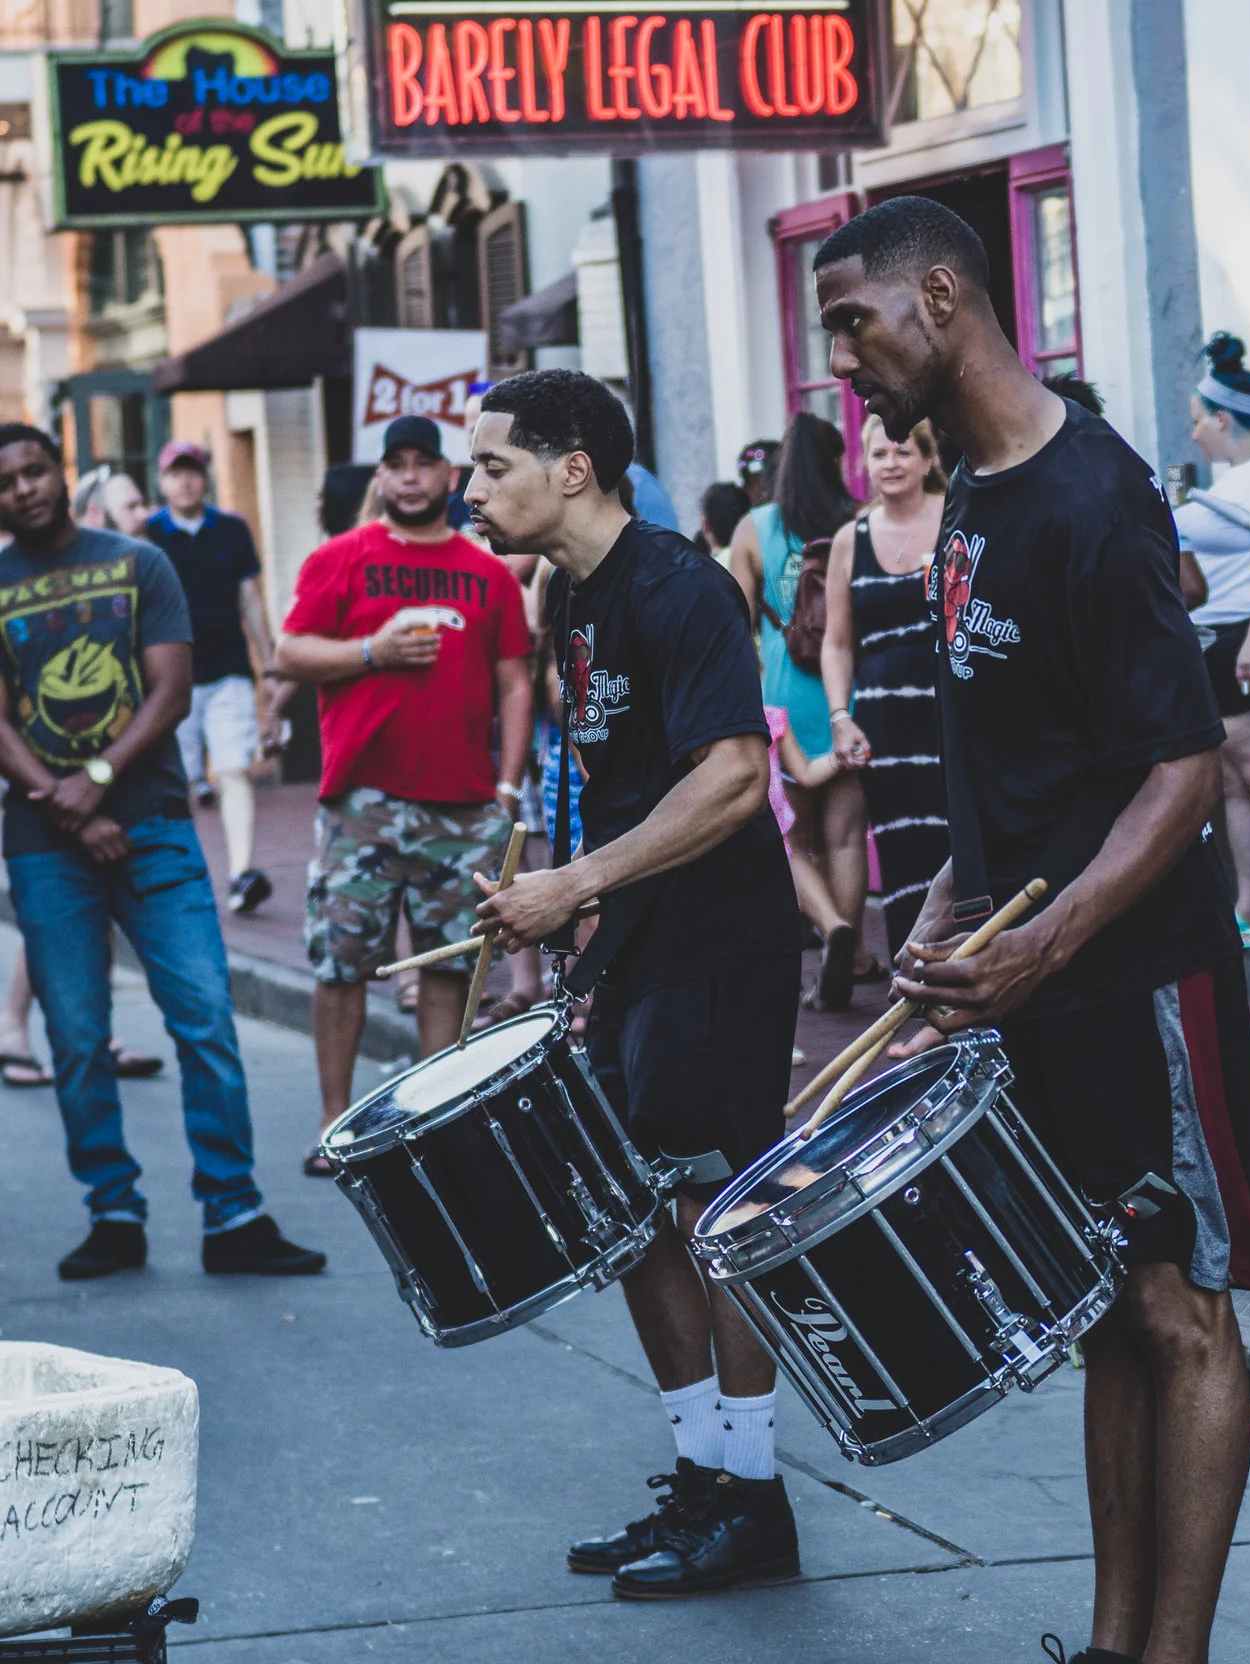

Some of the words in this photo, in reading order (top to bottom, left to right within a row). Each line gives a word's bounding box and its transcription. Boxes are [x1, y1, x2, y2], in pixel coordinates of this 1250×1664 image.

[86, 69, 169, 108] The
[191, 66, 331, 106] House
[388, 17, 571, 126] BARELY
[584, 16, 735, 121] LEGAL
[741, 14, 859, 116] CLUB
[174, 108, 203, 135] of
[209, 109, 256, 134] the
[69, 119, 239, 202] Rising
[373, 377, 397, 414] 2
[401, 385, 446, 414] for
[448, 381, 466, 414] 1
[364, 564, 489, 608] SECURITY
[771, 1290, 898, 1411] Pearl
[0, 1482, 150, 1545] ACCOUNT
